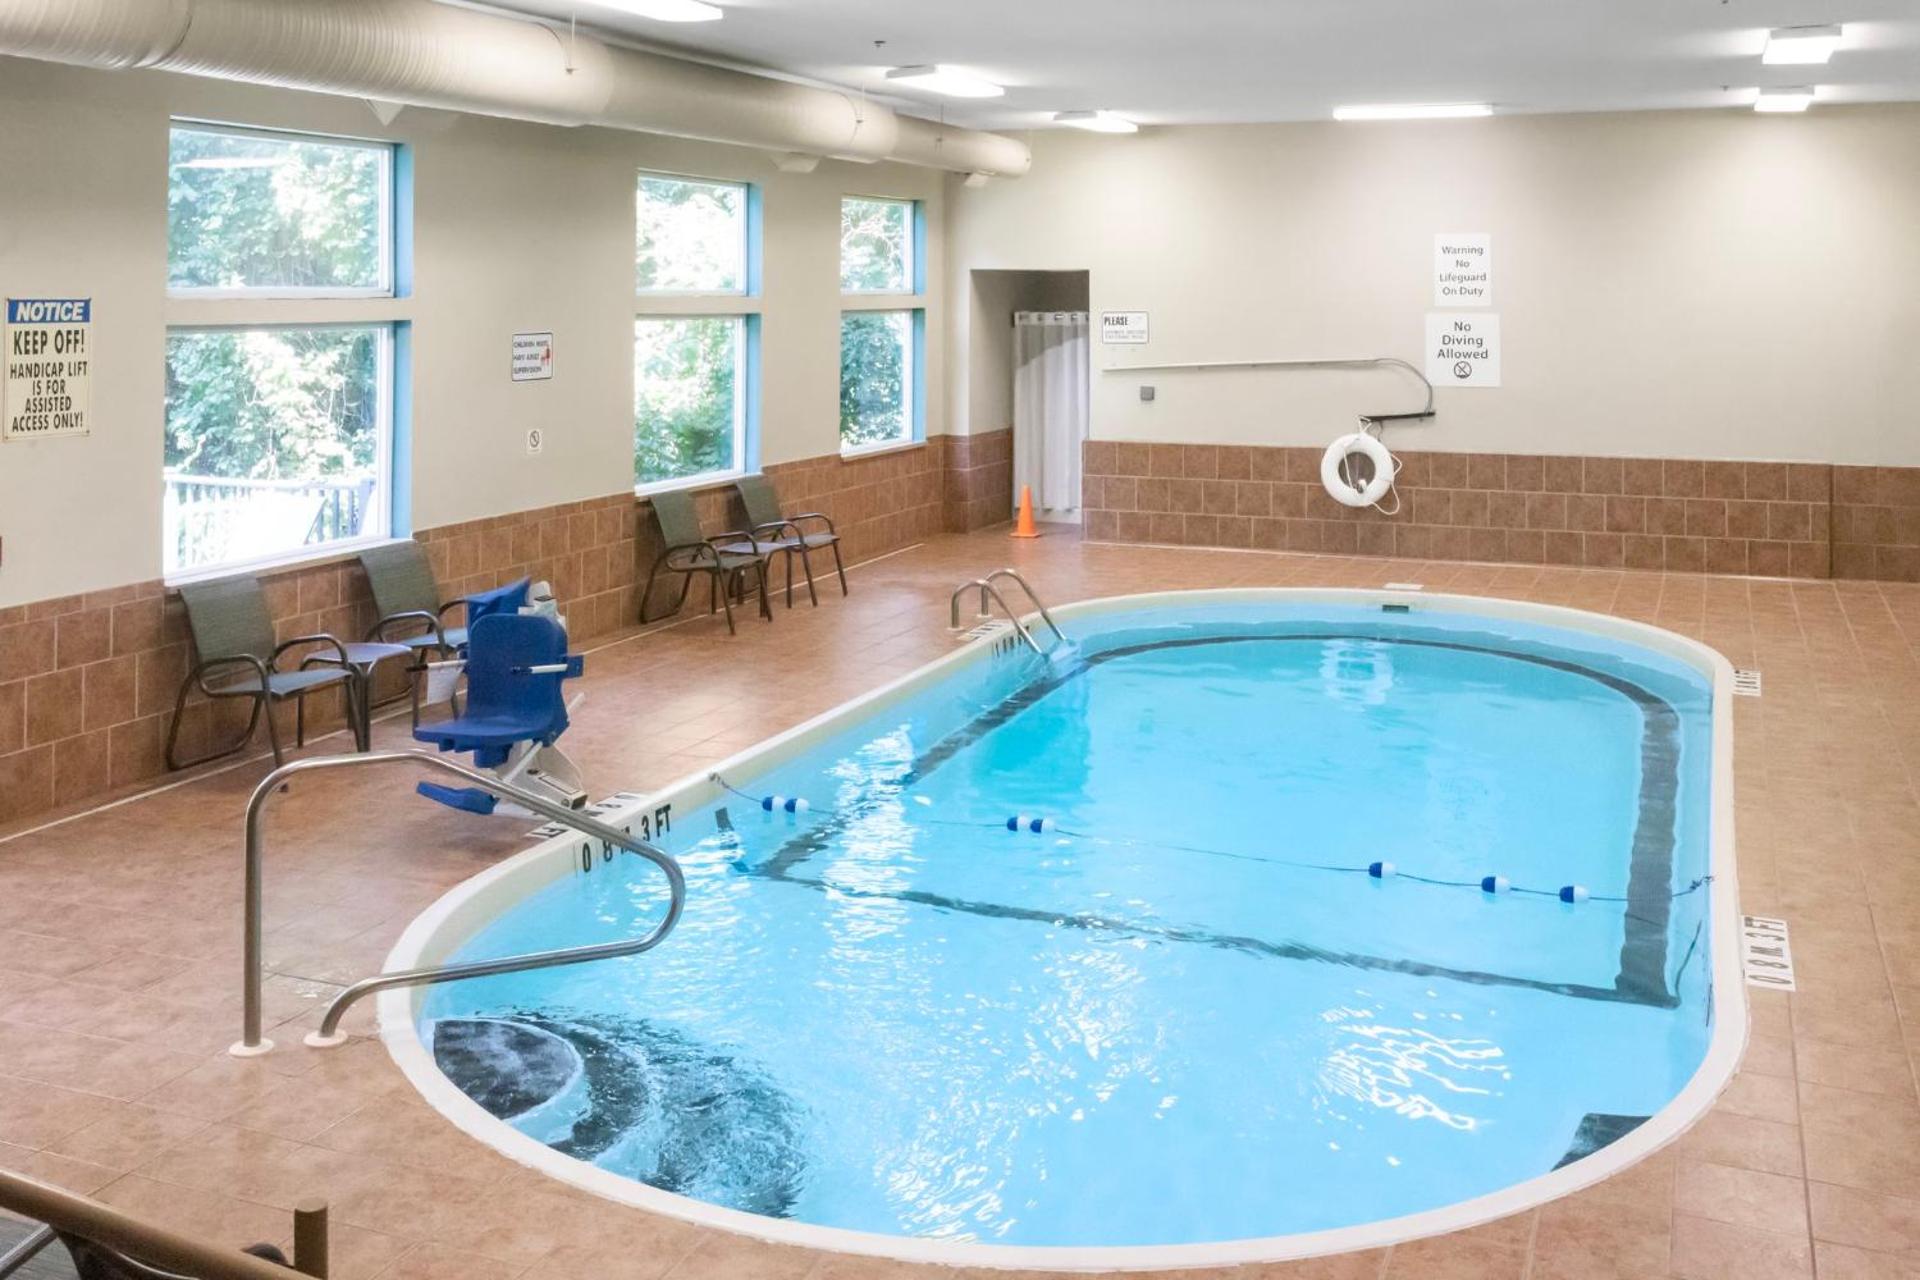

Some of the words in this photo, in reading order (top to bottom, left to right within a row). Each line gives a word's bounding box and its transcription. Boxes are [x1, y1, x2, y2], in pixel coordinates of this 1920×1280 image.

[1441, 246, 1484, 256] Warning
[1455, 260, 1470, 268] No
[1439, 272, 1487, 284] Lifeguard
[1442, 286, 1457, 296] On
[1460, 286, 1484, 298] Duty
[16, 301, 85, 321] NOTICE
[1104, 316, 1129, 326] PLEASE
[1454, 321, 1472, 332] No
[14, 330, 48, 355] KEEP
[54, 328, 84, 354] OFF!
[1442, 334, 1483, 348] Diving
[1437, 348, 1489, 360] Allowed
[10, 362, 64, 379] HANDICAP
[68, 361, 88, 377] LIFT
[33, 380, 42, 396] IS
[46, 379, 66, 395] FOR
[25, 396, 72, 413] ASSISTED
[13, 414, 49, 432] ACCESS
[53, 411, 83, 429] ONLY!
[655, 804, 671, 837] FT
